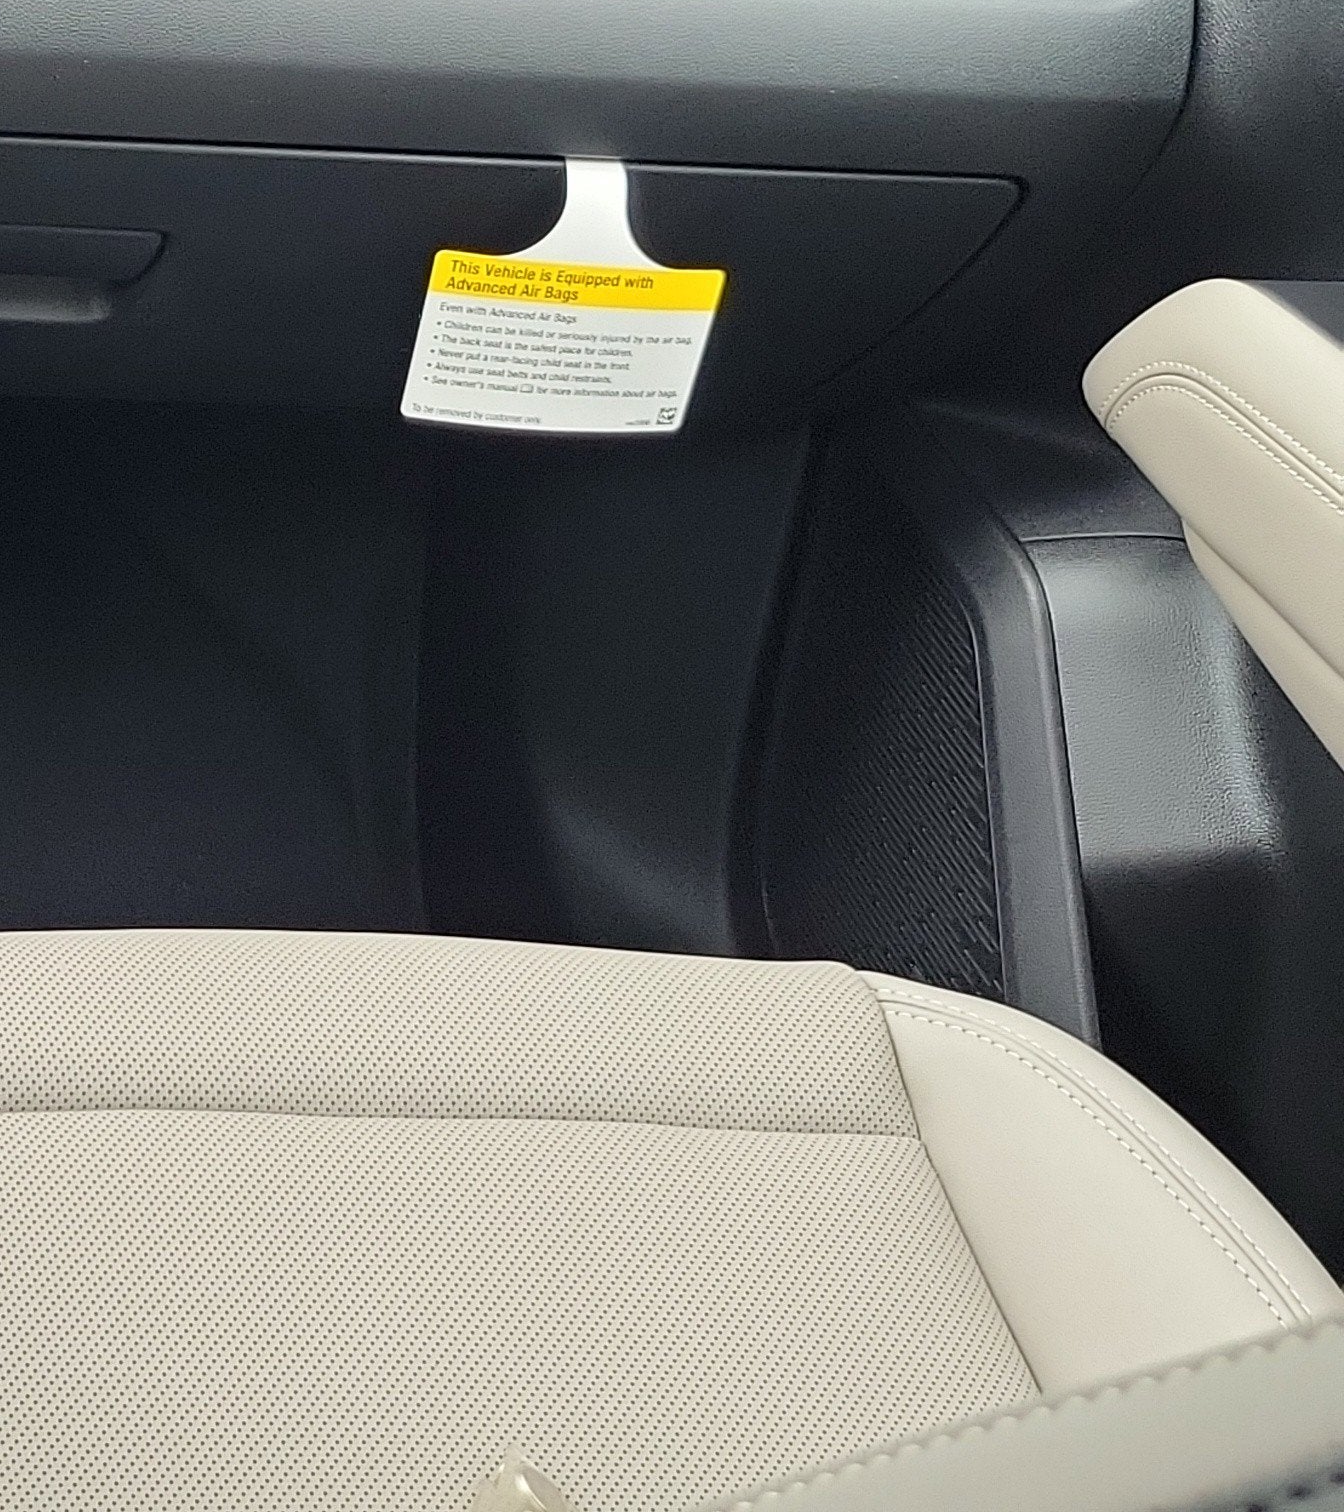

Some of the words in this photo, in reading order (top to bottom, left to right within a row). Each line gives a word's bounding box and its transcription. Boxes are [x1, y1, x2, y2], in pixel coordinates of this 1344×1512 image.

[451, 259, 479, 275] This
[485, 264, 535, 281] Vehicle
[539, 269, 552, 283] is
[555, 270, 620, 289] Equipped
[625, 275, 654, 289] with
[445, 276, 516, 296] Advanced
[519, 283, 541, 298] Air
[544, 287, 578, 303] Bags
[439, 302, 463, 313] Even
[466, 306, 487, 316] with
[489, 308, 536, 320] Advanced
[538, 311, 551, 321] Air
[553, 313, 577, 324] Bags
[444, 320, 483, 332] Children
[485, 325, 502, 334] can
[505, 326, 516, 335] be
[519, 327, 544, 338] killed
[441, 334, 457, 344] The
[438, 348, 464, 358] Never
[466, 351, 481, 361] put
[434, 362, 466, 374] Always
[468, 365, 484, 375] use
[431, 375, 447, 385] See
